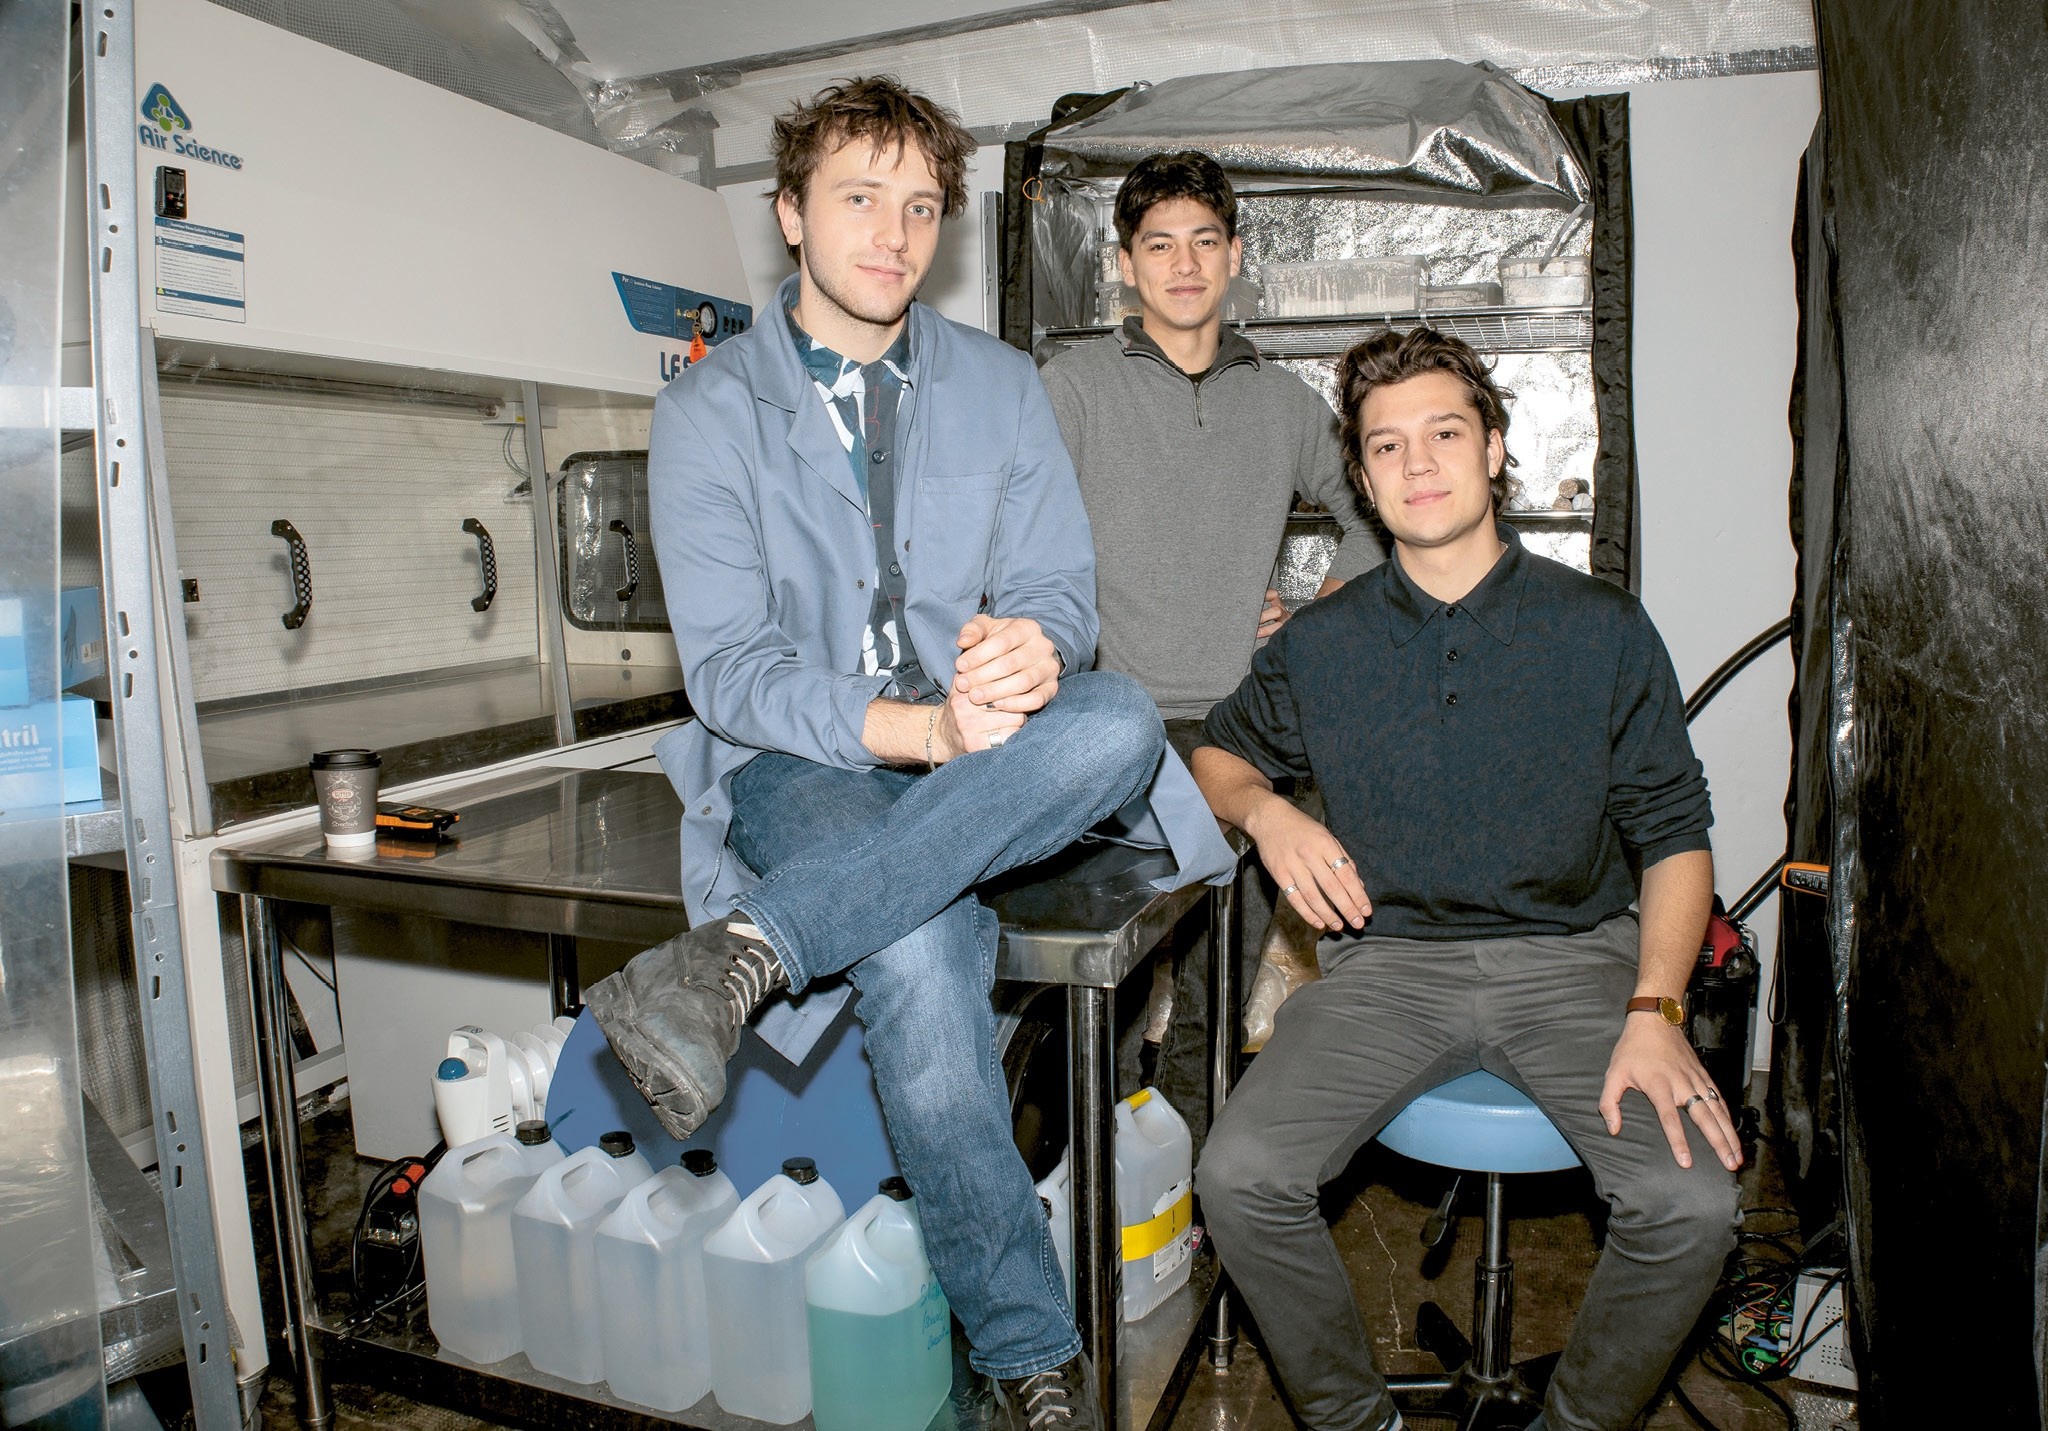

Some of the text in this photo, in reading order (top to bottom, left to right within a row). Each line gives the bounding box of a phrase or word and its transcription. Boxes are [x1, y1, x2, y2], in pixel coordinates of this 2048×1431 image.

[139, 124, 242, 170] Air Science
[0, 723, 40, 748] tril
